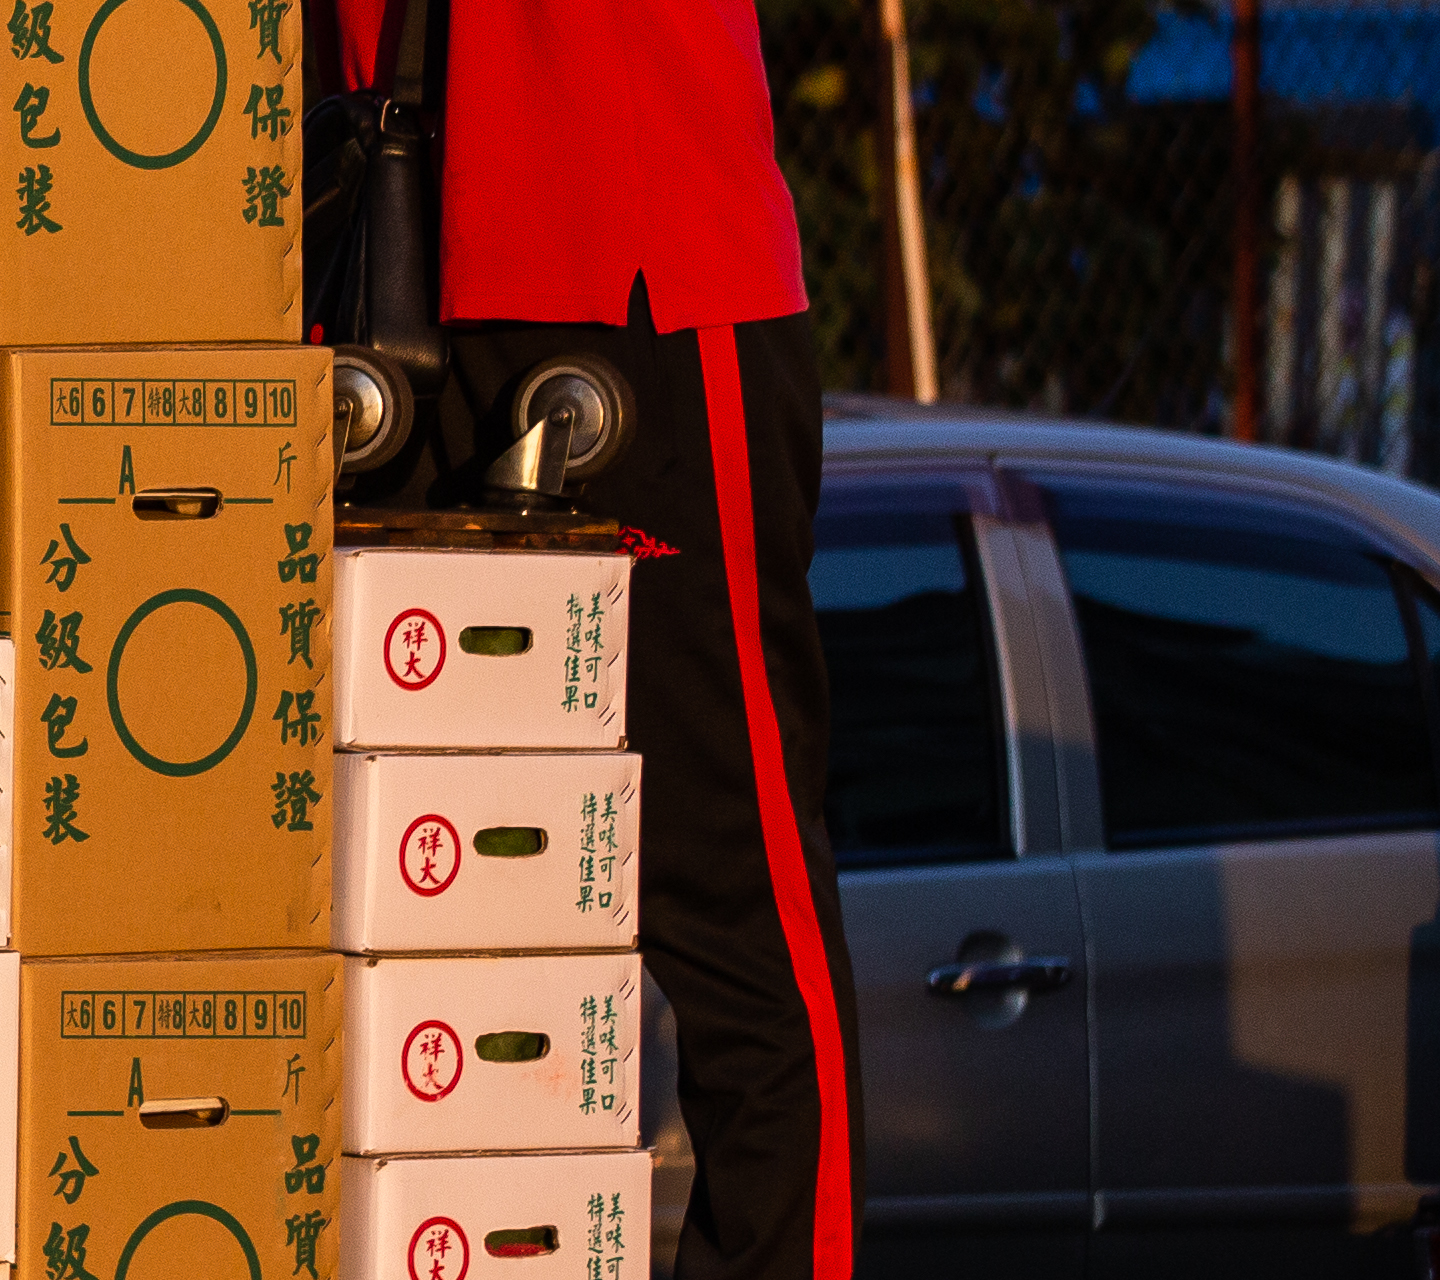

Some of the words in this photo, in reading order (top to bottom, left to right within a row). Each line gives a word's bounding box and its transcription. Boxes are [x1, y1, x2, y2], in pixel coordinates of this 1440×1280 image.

[91, 386, 107, 418] 6
[121, 386, 136, 417] 7
[213, 386, 229, 419] 8
[243, 386, 259, 419] 9
[267, 385, 292, 419] 10
[116, 444, 136, 495] A
[272, 441, 297, 494] 斤
[268, 521, 322, 833] 品質保證
[402, 621, 429, 681] 祥大
[582, 591, 604, 709] 美味可口
[33, 522, 93, 847] 分級包裝
[417, 826, 443, 887] 祥大
[596, 791, 619, 910] 美味可口
[101, 998, 117, 1031] 6
[131, 998, 147, 1030] 7
[223, 998, 238, 1031] 8
[252, 997, 269, 1031] 9
[277, 997, 303, 1030] 10
[126, 1057, 144, 1108] A
[281, 1052, 307, 1105] 斤
[597, 993, 618, 1111] 美味可口
